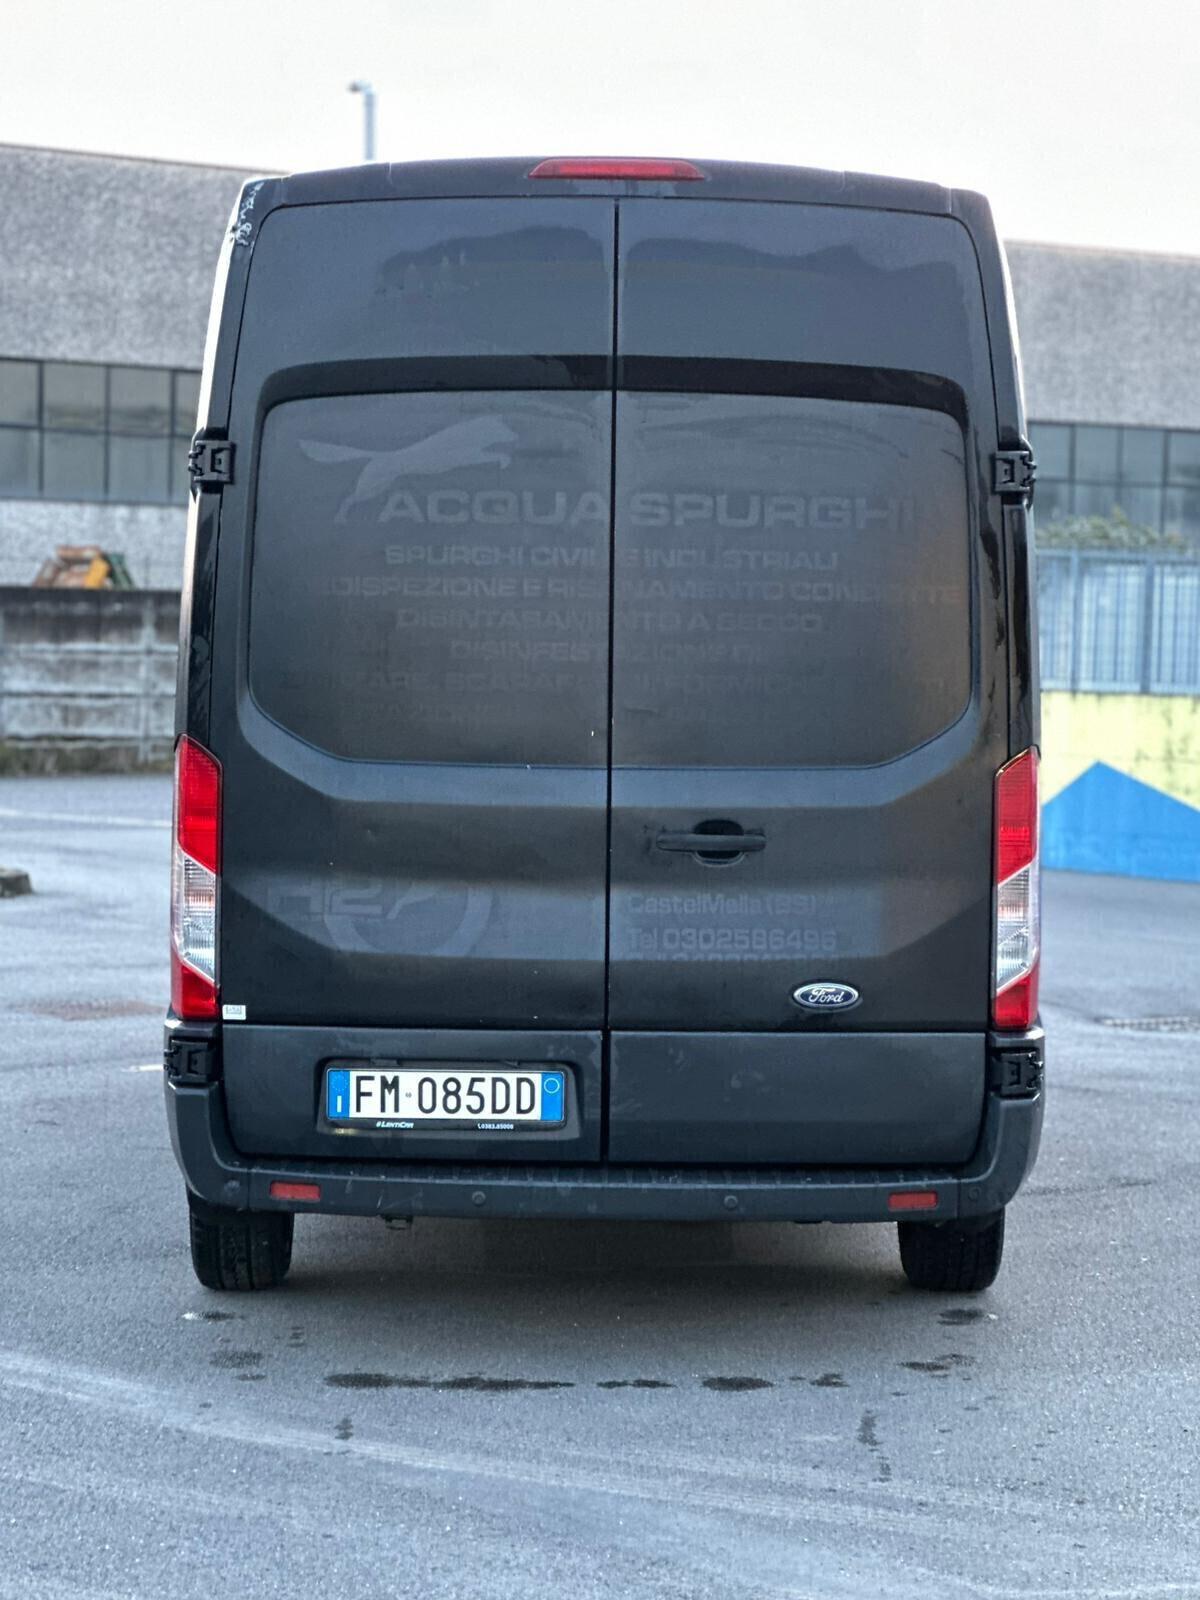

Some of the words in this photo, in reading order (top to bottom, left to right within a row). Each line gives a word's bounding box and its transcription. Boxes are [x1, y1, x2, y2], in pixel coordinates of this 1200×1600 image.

[377, 489, 613, 525] ACQUA
[629, 491, 915, 532] SPURGHI
[384, 545, 524, 567] SPURGHI
[808, 987, 844, 1003] Ford
[355, 1075, 400, 1113] FM
[417, 1076, 536, 1115] 085DD
